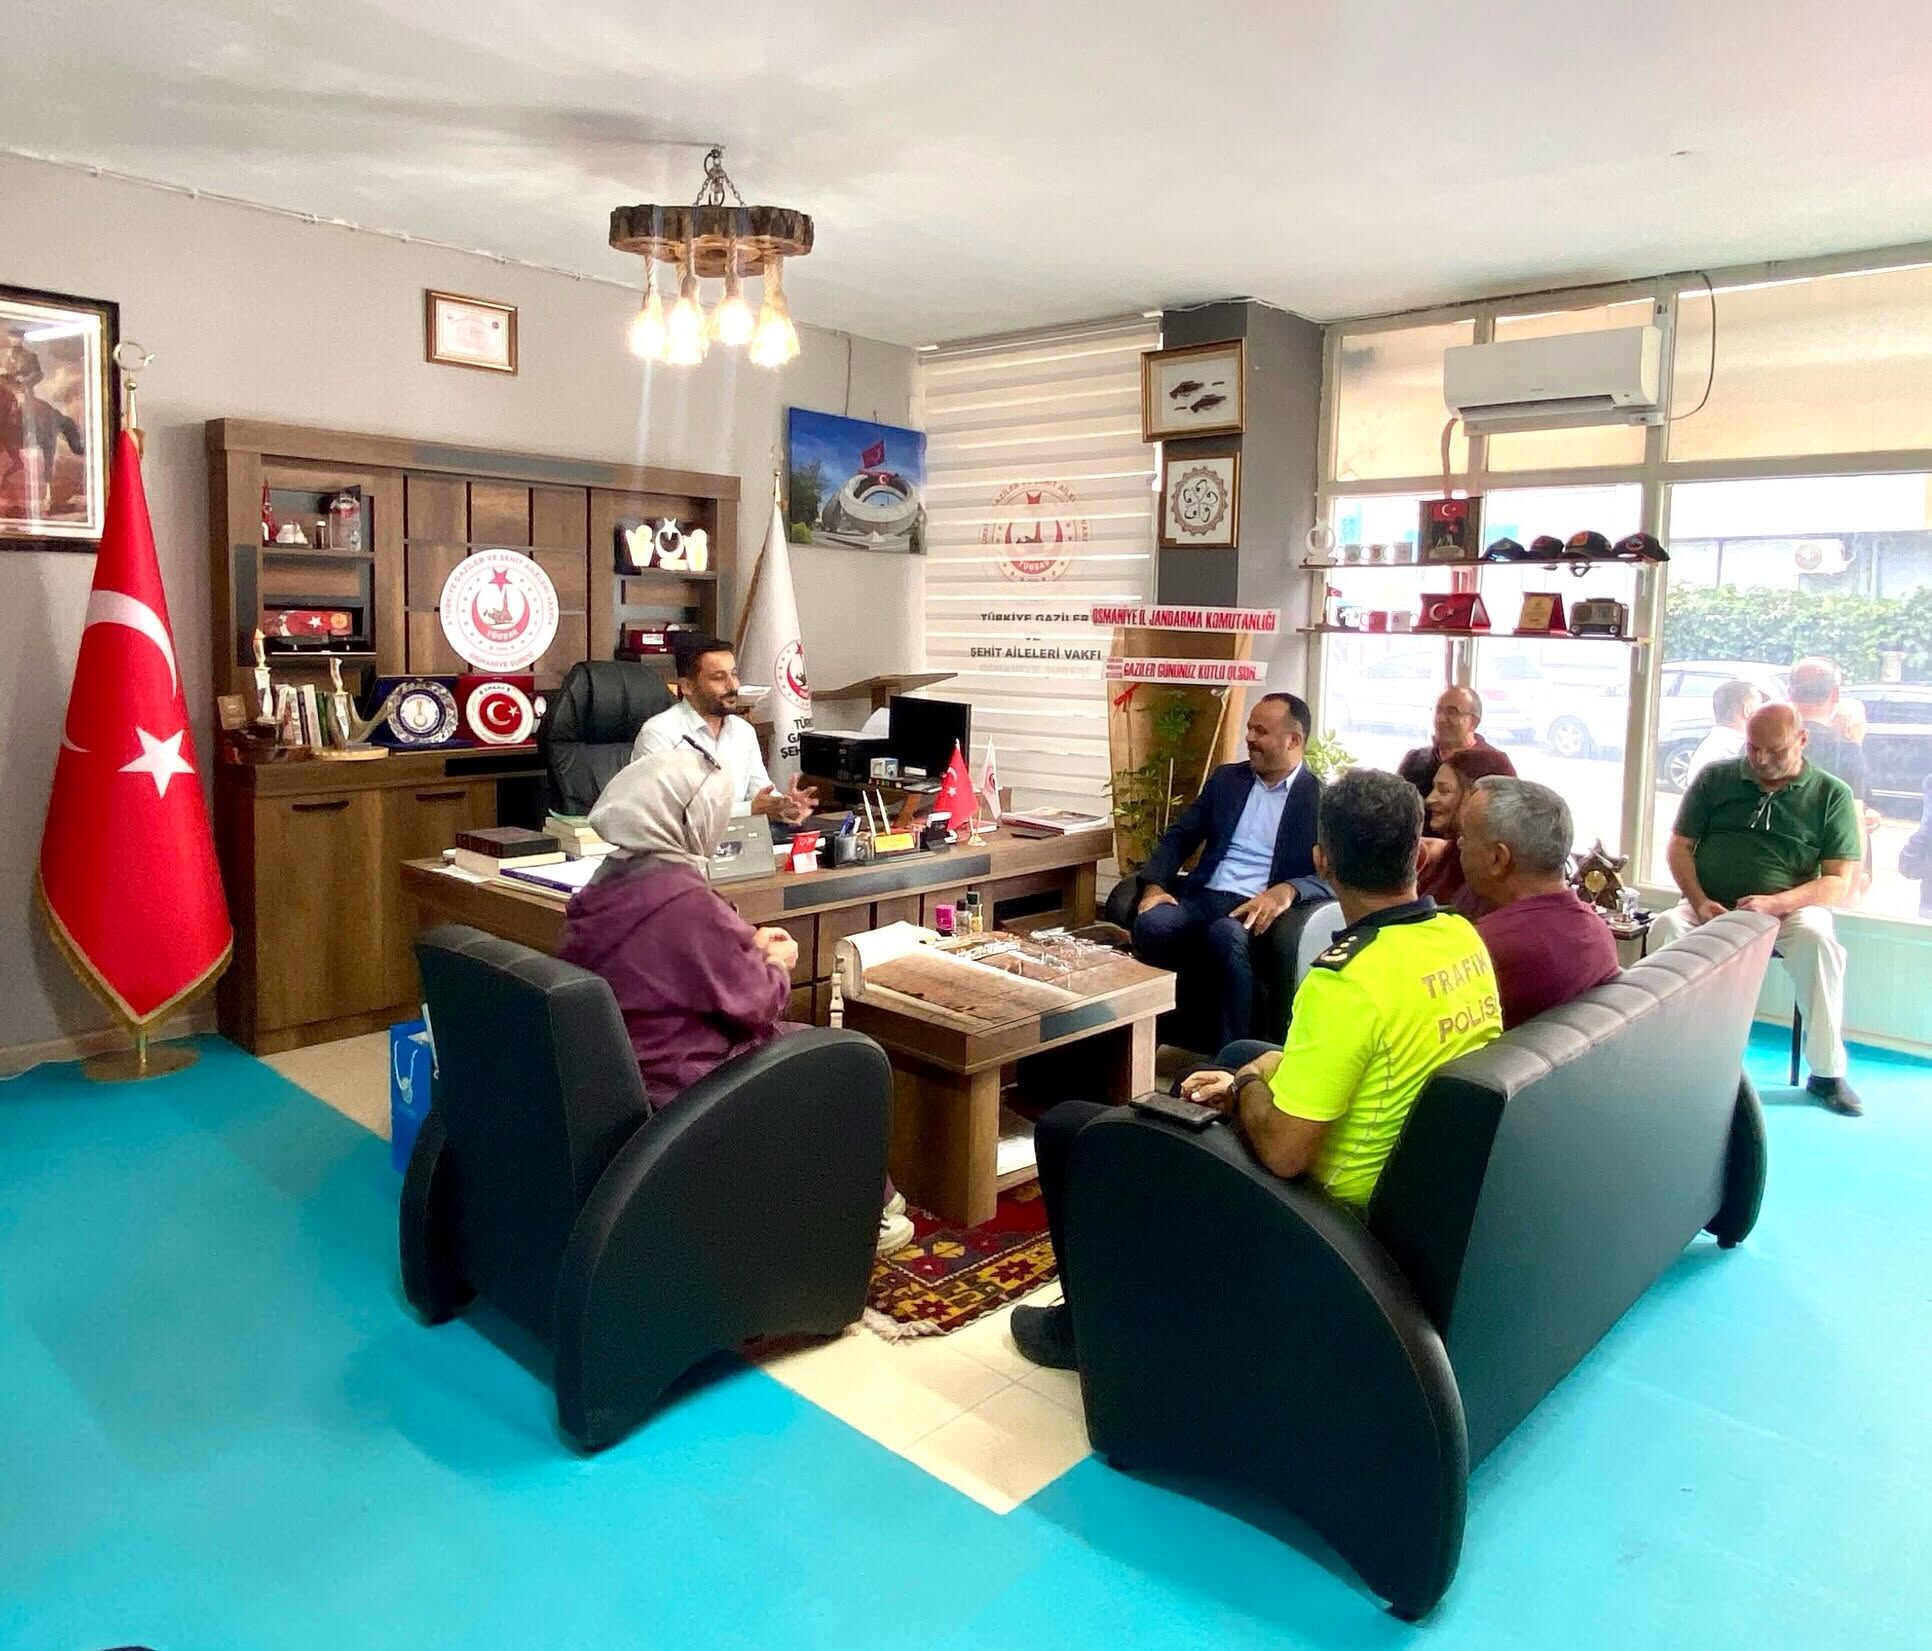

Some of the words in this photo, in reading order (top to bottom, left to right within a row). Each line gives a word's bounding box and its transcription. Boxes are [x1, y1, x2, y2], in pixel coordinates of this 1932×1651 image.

[1092, 605, 1137, 625] OSMANİYE
[1149, 610, 1203, 628] JANDARMA
[1205, 611, 1275, 631] KOMUTANLIĞI
[970, 645, 1003, 658] ŞEHİT
[1005, 645, 1061, 659] AİLELERİ
[1064, 648, 1101, 660] VAKFI
[1124, 660, 1156, 678] GAZİLER
[1198, 664, 1226, 680] KUTLU
